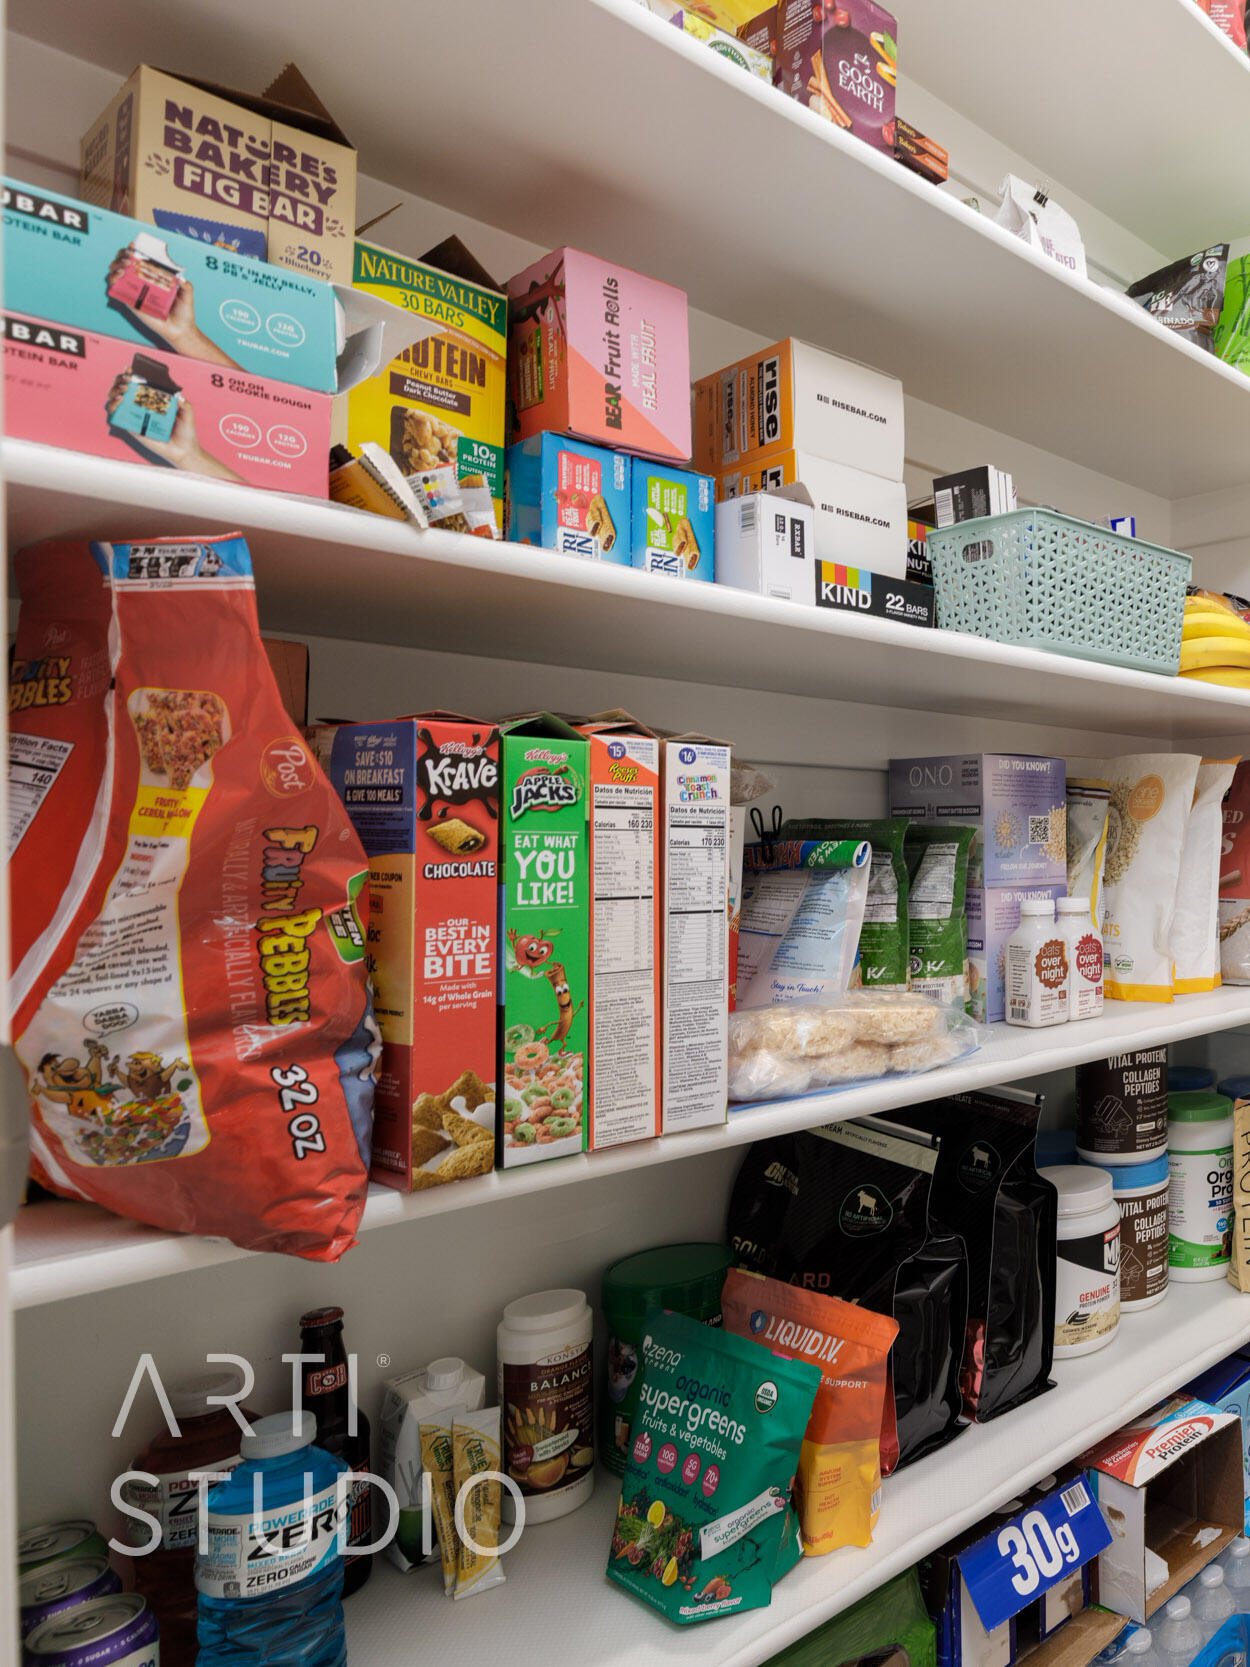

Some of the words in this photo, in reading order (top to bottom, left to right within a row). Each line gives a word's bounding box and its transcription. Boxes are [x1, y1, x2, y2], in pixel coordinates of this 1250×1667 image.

[838, 59, 885, 100] GOOD
[838, 75, 883, 113] EARTH
[163, 124, 337, 206] BAKERY
[183, 163, 240, 205] FIG
[252, 189, 316, 230] BAR
[52, 229, 81, 247] BAR
[205, 255, 219, 271] 8
[297, 246, 322, 266] 20
[284, 256, 332, 281] Blueberry
[251, 275, 284, 292] JELLY
[360, 250, 436, 292] NATURE
[437, 279, 499, 326] VALLEY
[400, 291, 419, 311] 30
[423, 296, 465, 328] BARS
[602, 276, 621, 327] Rolls
[237, 338, 290, 359] TRUBAR.COM
[640, 319, 657, 368] FRUIT
[602, 330, 622, 379] Fruit
[211, 374, 224, 388] 8
[405, 378, 432, 393] Peanut
[433, 386, 457, 399] Butter
[641, 368, 658, 411] REAL
[229, 384, 270, 400] COOKIE
[273, 395, 312, 410] DOUGH
[403, 385, 422, 399] Dark
[423, 390, 459, 407] Chocolate
[604, 382, 623, 430] BEAR
[765, 358, 779, 440] rise
[832, 399, 887, 425] RISEBAR.COM
[238, 452, 292, 469] TRUBAR.COM
[462, 453, 497, 468] PROTEIN
[471, 443, 497, 462] 10g
[836, 507, 890, 529] RISEBAR.COM
[822, 581, 872, 610] KIND
[885, 592, 905, 612] 22
[906, 604, 928, 617] BARS
[355, 750, 375, 767] SAVE
[379, 749, 393, 767] $10
[439, 741, 484, 758] Kellogg's
[524, 748, 569, 765] Kellogg's
[269, 742, 306, 790] Post
[1012, 760, 1026, 771] YOU
[1026, 761, 1051, 774] KNOW?
[31, 772, 52, 785] 140
[356, 768, 405, 786] BREAKFAST
[523, 774, 563, 787] APPLE
[612, 771, 638, 783] Puffs
[676, 774, 717, 785] Cinnamon
[909, 765, 953, 788] ONO
[594, 785, 613, 794] Datos
[625, 786, 653, 796] Nutrición
[679, 789, 719, 801] Crunch
[511, 785, 576, 819] JACKS
[670, 806, 688, 815] Datos
[698, 806, 725, 816] Nutrición
[628, 819, 640, 829] 160
[640, 819, 653, 829] 230
[515, 835, 538, 848] EAT
[544, 835, 578, 848] WHAT
[701, 837, 713, 847] 170
[713, 837, 725, 847] 230
[261, 825, 319, 911] FRUITY
[423, 861, 496, 879] CHOCOLATE
[513, 850, 576, 880] YOU
[516, 881, 575, 905] LIKE!
[446, 918, 469, 927] OUR
[426, 927, 469, 941] BEST
[472, 925, 491, 938] IN
[425, 939, 490, 957] EVERY
[1040, 943, 1061, 957] oats
[1078, 941, 1097, 956] oats
[256, 906, 323, 1028] PEBBLES
[423, 953, 492, 979] BITE
[1041, 956, 1062, 967] over
[1079, 953, 1098, 964] over
[1041, 967, 1065, 982] night
[1079, 963, 1101, 979] night
[439, 983, 459, 993] Made
[447, 991, 472, 1003] Whole
[473, 989, 493, 1000] Grain
[770, 979, 786, 992] Stay
[797, 983, 824, 993] Touch!
[452, 1000, 477, 1012] serving
[1107, 1053, 1133, 1071] VITAL
[1122, 1066, 1161, 1085] COLLAGEN
[271, 1064, 319, 1113] 32
[1124, 1080, 1160, 1097] PEPTIDES
[287, 1113, 326, 1160] OZ
[1119, 1201, 1145, 1221] VITAL
[1134, 1210, 1167, 1231] COLLAGEN
[1135, 1225, 1167, 1244] PEPTIDES
[1079, 1283, 1111, 1303] GENUINE
[764, 1315, 823, 1357] LIQUID
[649, 1343, 683, 1367] zena
[675, 1375, 732, 1408] organic
[825, 1376, 868, 1391] SUPPORT
[639, 1383, 747, 1445] supergreens
[642, 1409, 668, 1433] fruits
[679, 1429, 728, 1461] vegetables
[1145, 1423, 1197, 1459] Premier
[1158, 1430, 1203, 1460] Protein
[1102, 1440, 1139, 1465] Strawberries
[248, 1494, 336, 1536] POWERADE
[714, 1500, 773, 1544] supergreens
[247, 1497, 351, 1562] ZERO
[996, 1510, 1080, 1597] 30g
[246, 1570, 289, 1589] ZERO
